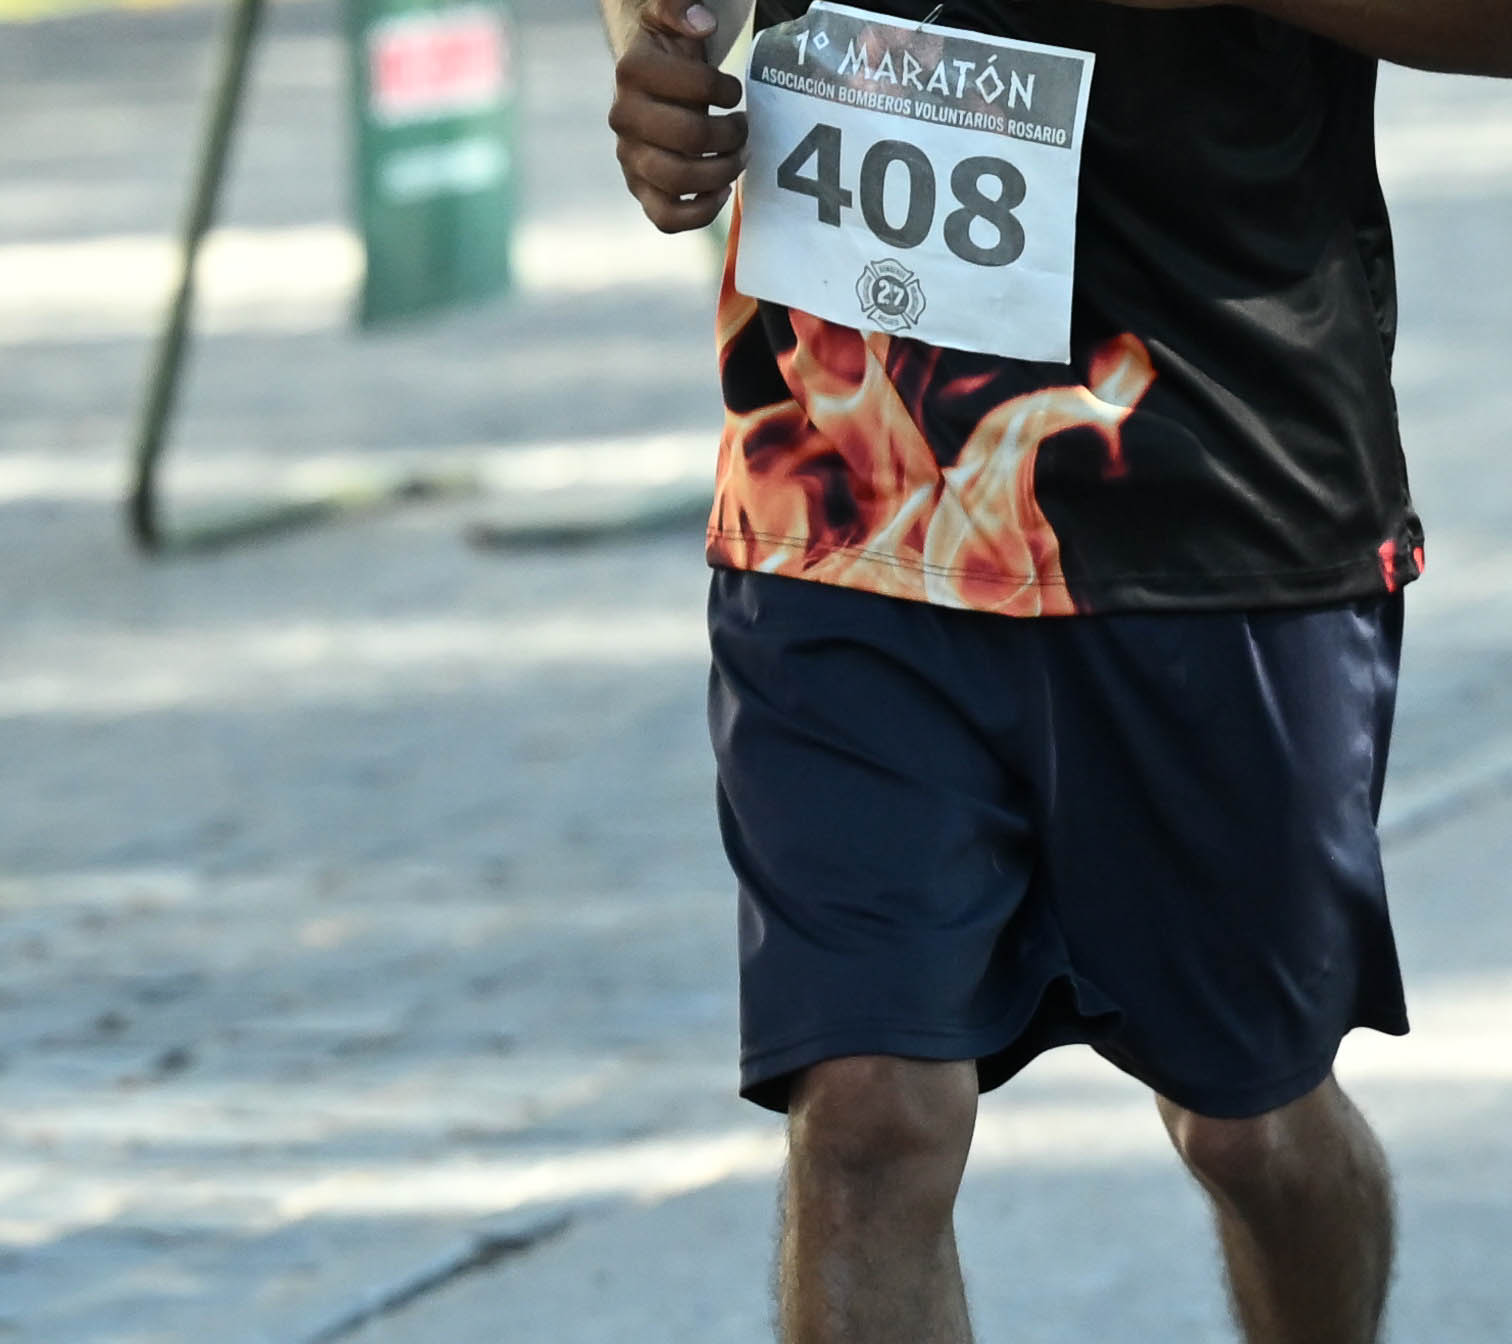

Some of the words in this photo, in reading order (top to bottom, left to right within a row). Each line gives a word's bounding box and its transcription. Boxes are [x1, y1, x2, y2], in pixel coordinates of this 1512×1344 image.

[761, 65, 835, 100] ASOCIACIÓN
[838, 85, 912, 116] BOMBEROS
[914, 101, 1005, 132] VOLUNTARIOS
[1007, 119, 1067, 145] ROSARIO
[837, 37, 1036, 111] MARATÓN
[776, 122, 1027, 268] 408
[877, 279, 905, 307] 27
